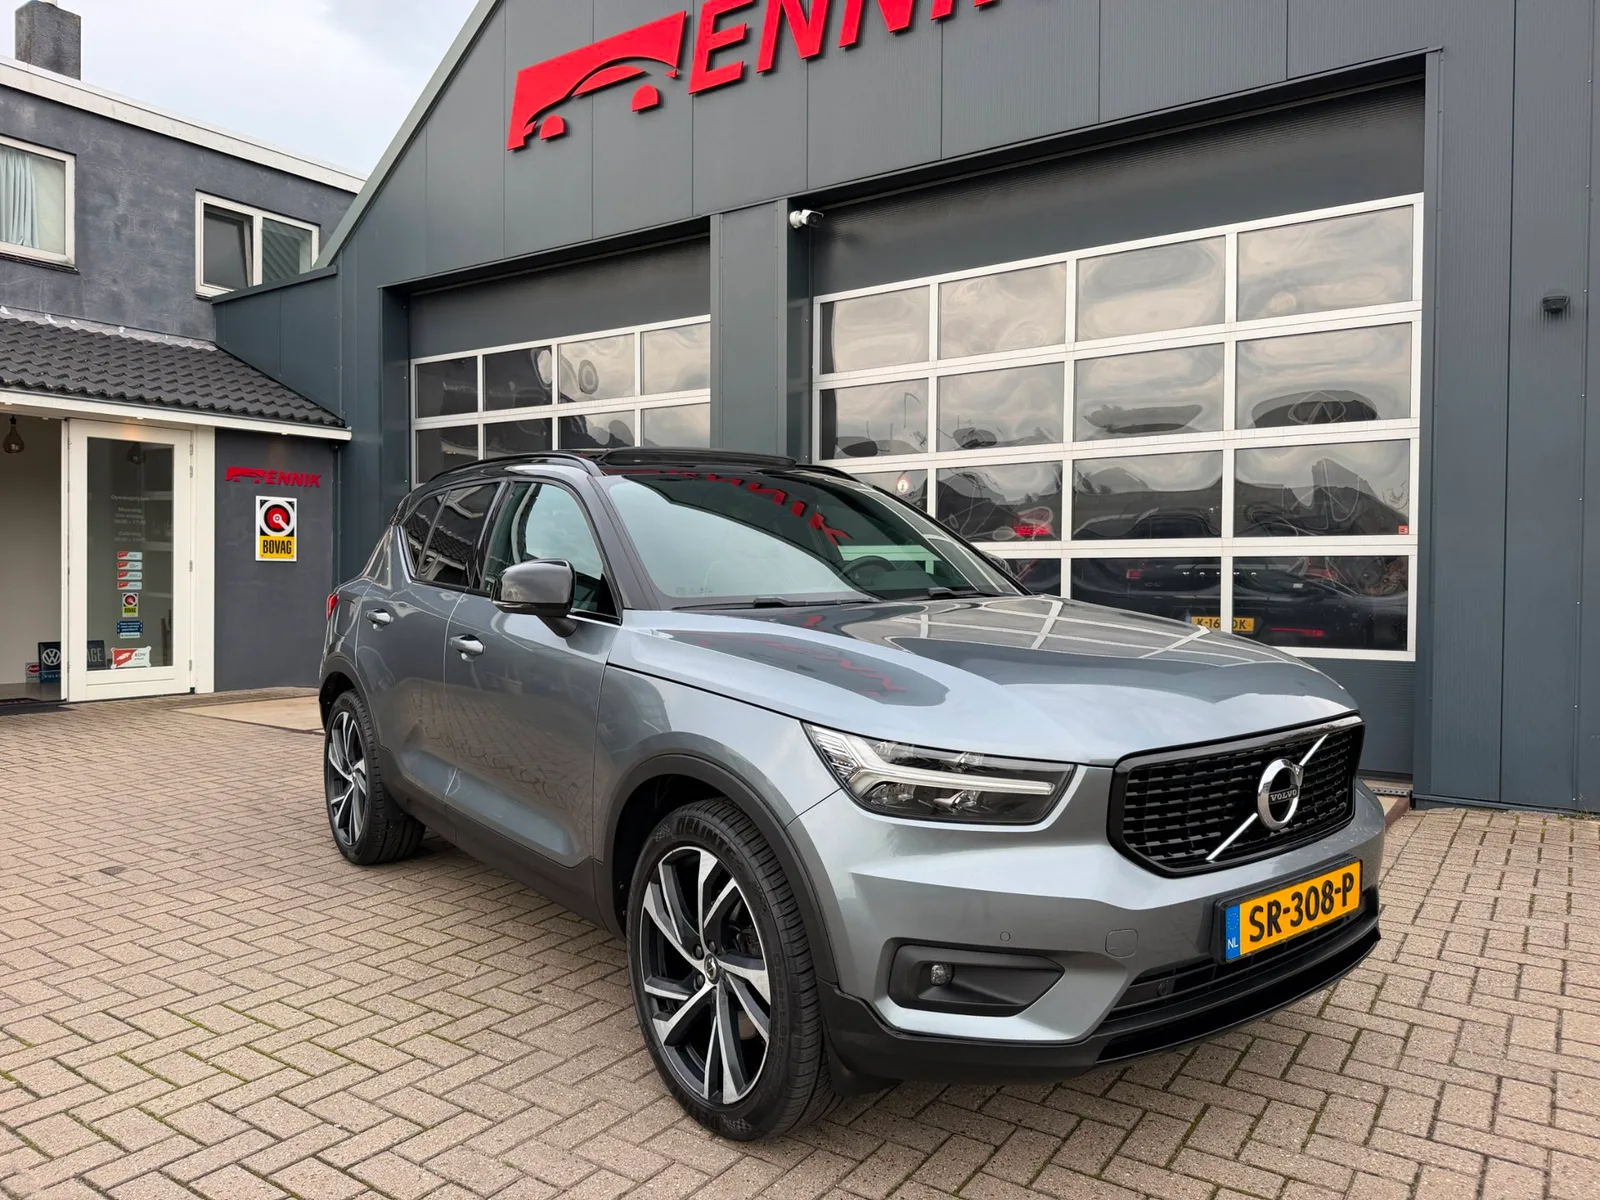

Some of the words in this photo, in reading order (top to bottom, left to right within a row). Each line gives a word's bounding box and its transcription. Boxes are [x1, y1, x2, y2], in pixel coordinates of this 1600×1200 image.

[263, 540, 292, 554] BOVAG
[1270, 788, 1298, 802] VOLVO
[1249, 872, 1355, 943] SR-308-P
[1227, 936, 1239, 950] NL
